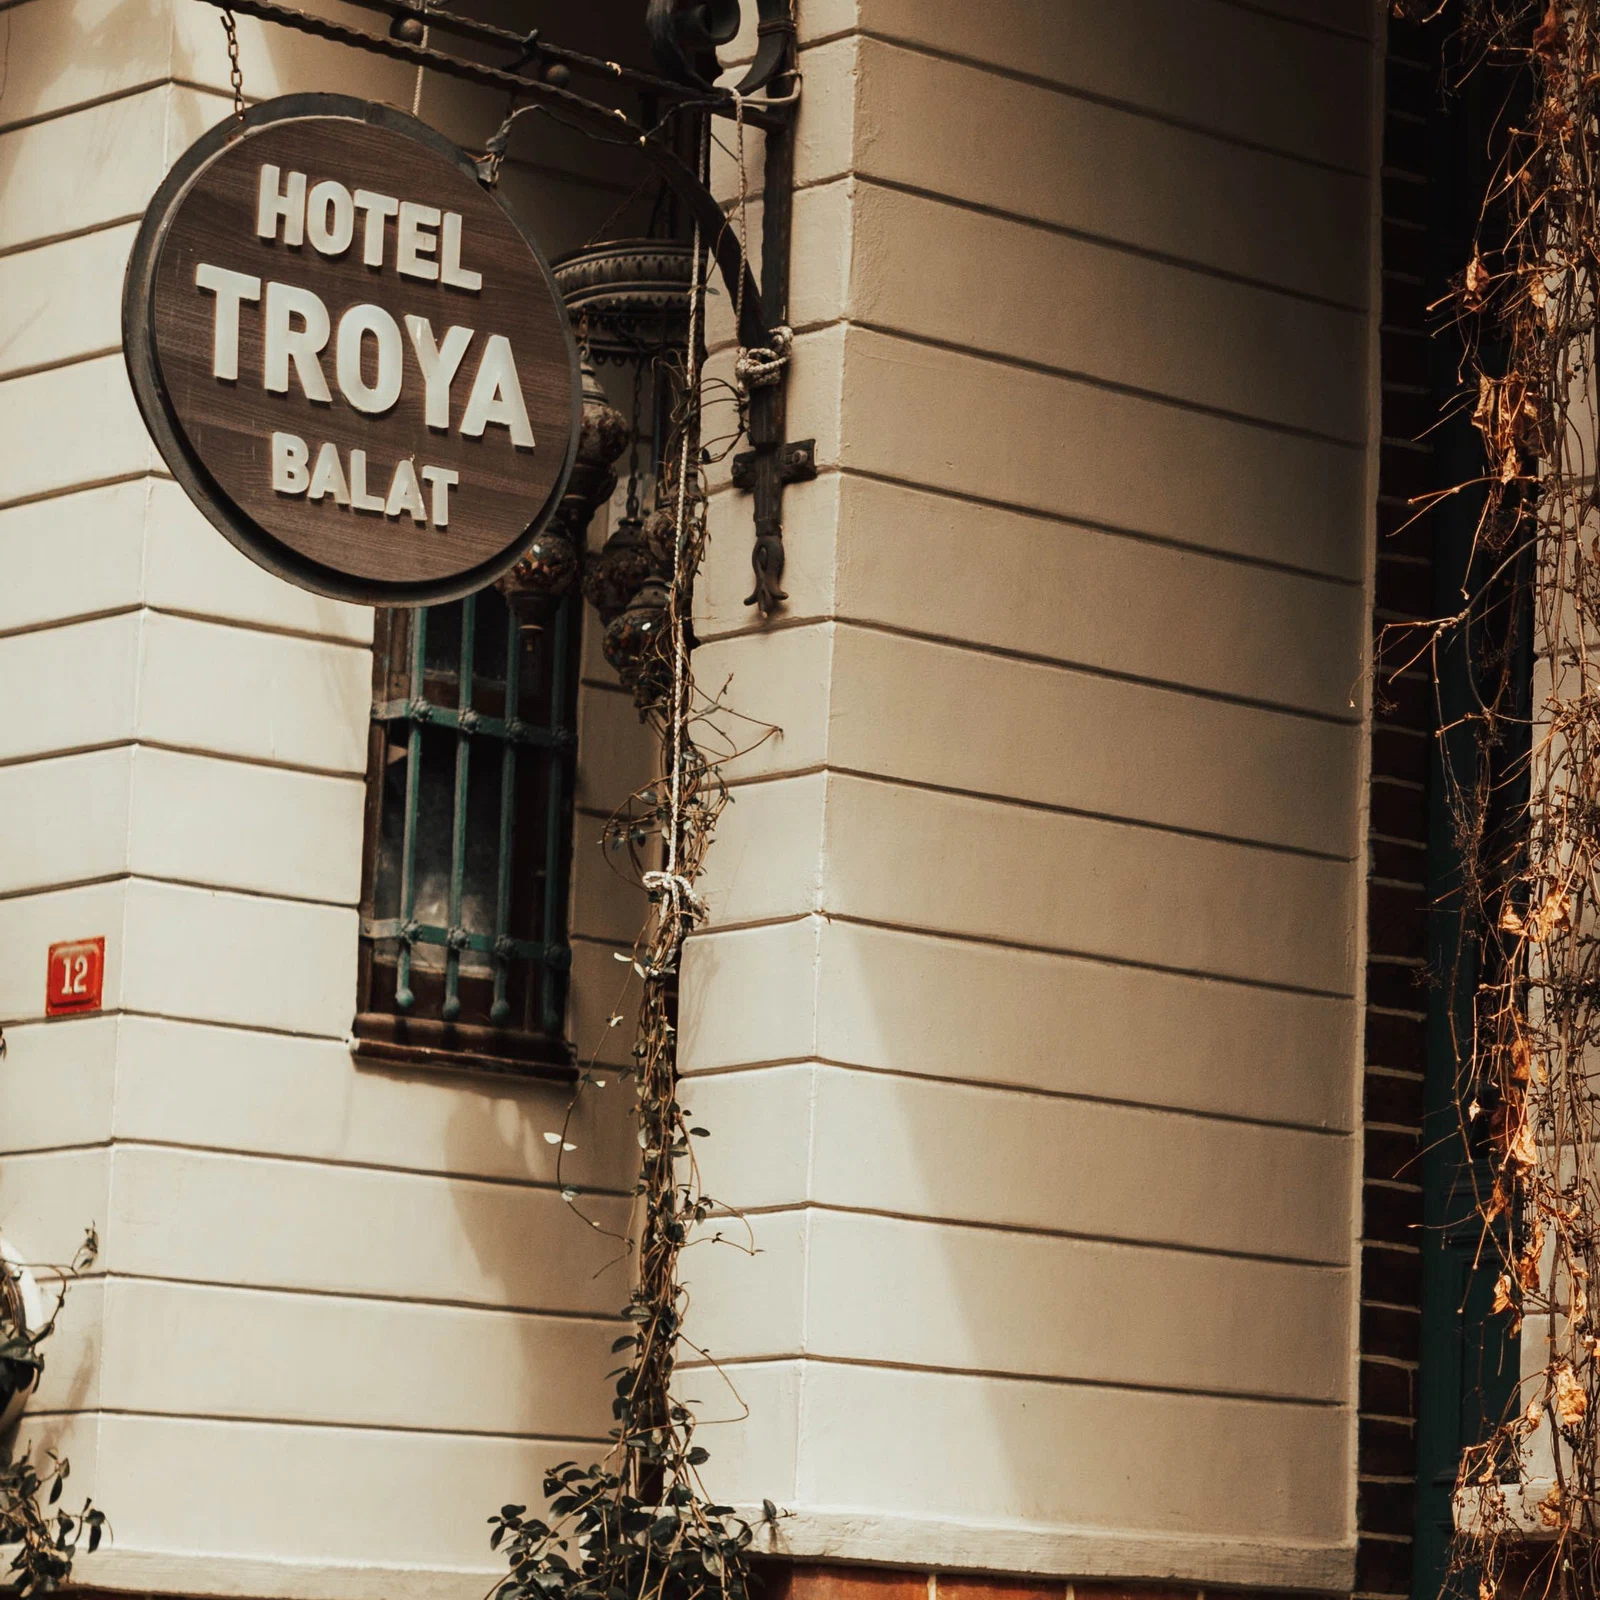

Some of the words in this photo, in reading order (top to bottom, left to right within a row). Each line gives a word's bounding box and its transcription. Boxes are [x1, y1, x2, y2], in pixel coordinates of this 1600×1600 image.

[257, 163, 483, 291] HOTEL
[196, 262, 536, 448] TROYA
[271, 431, 459, 527] BALAT
[61, 955, 88, 995] 12
